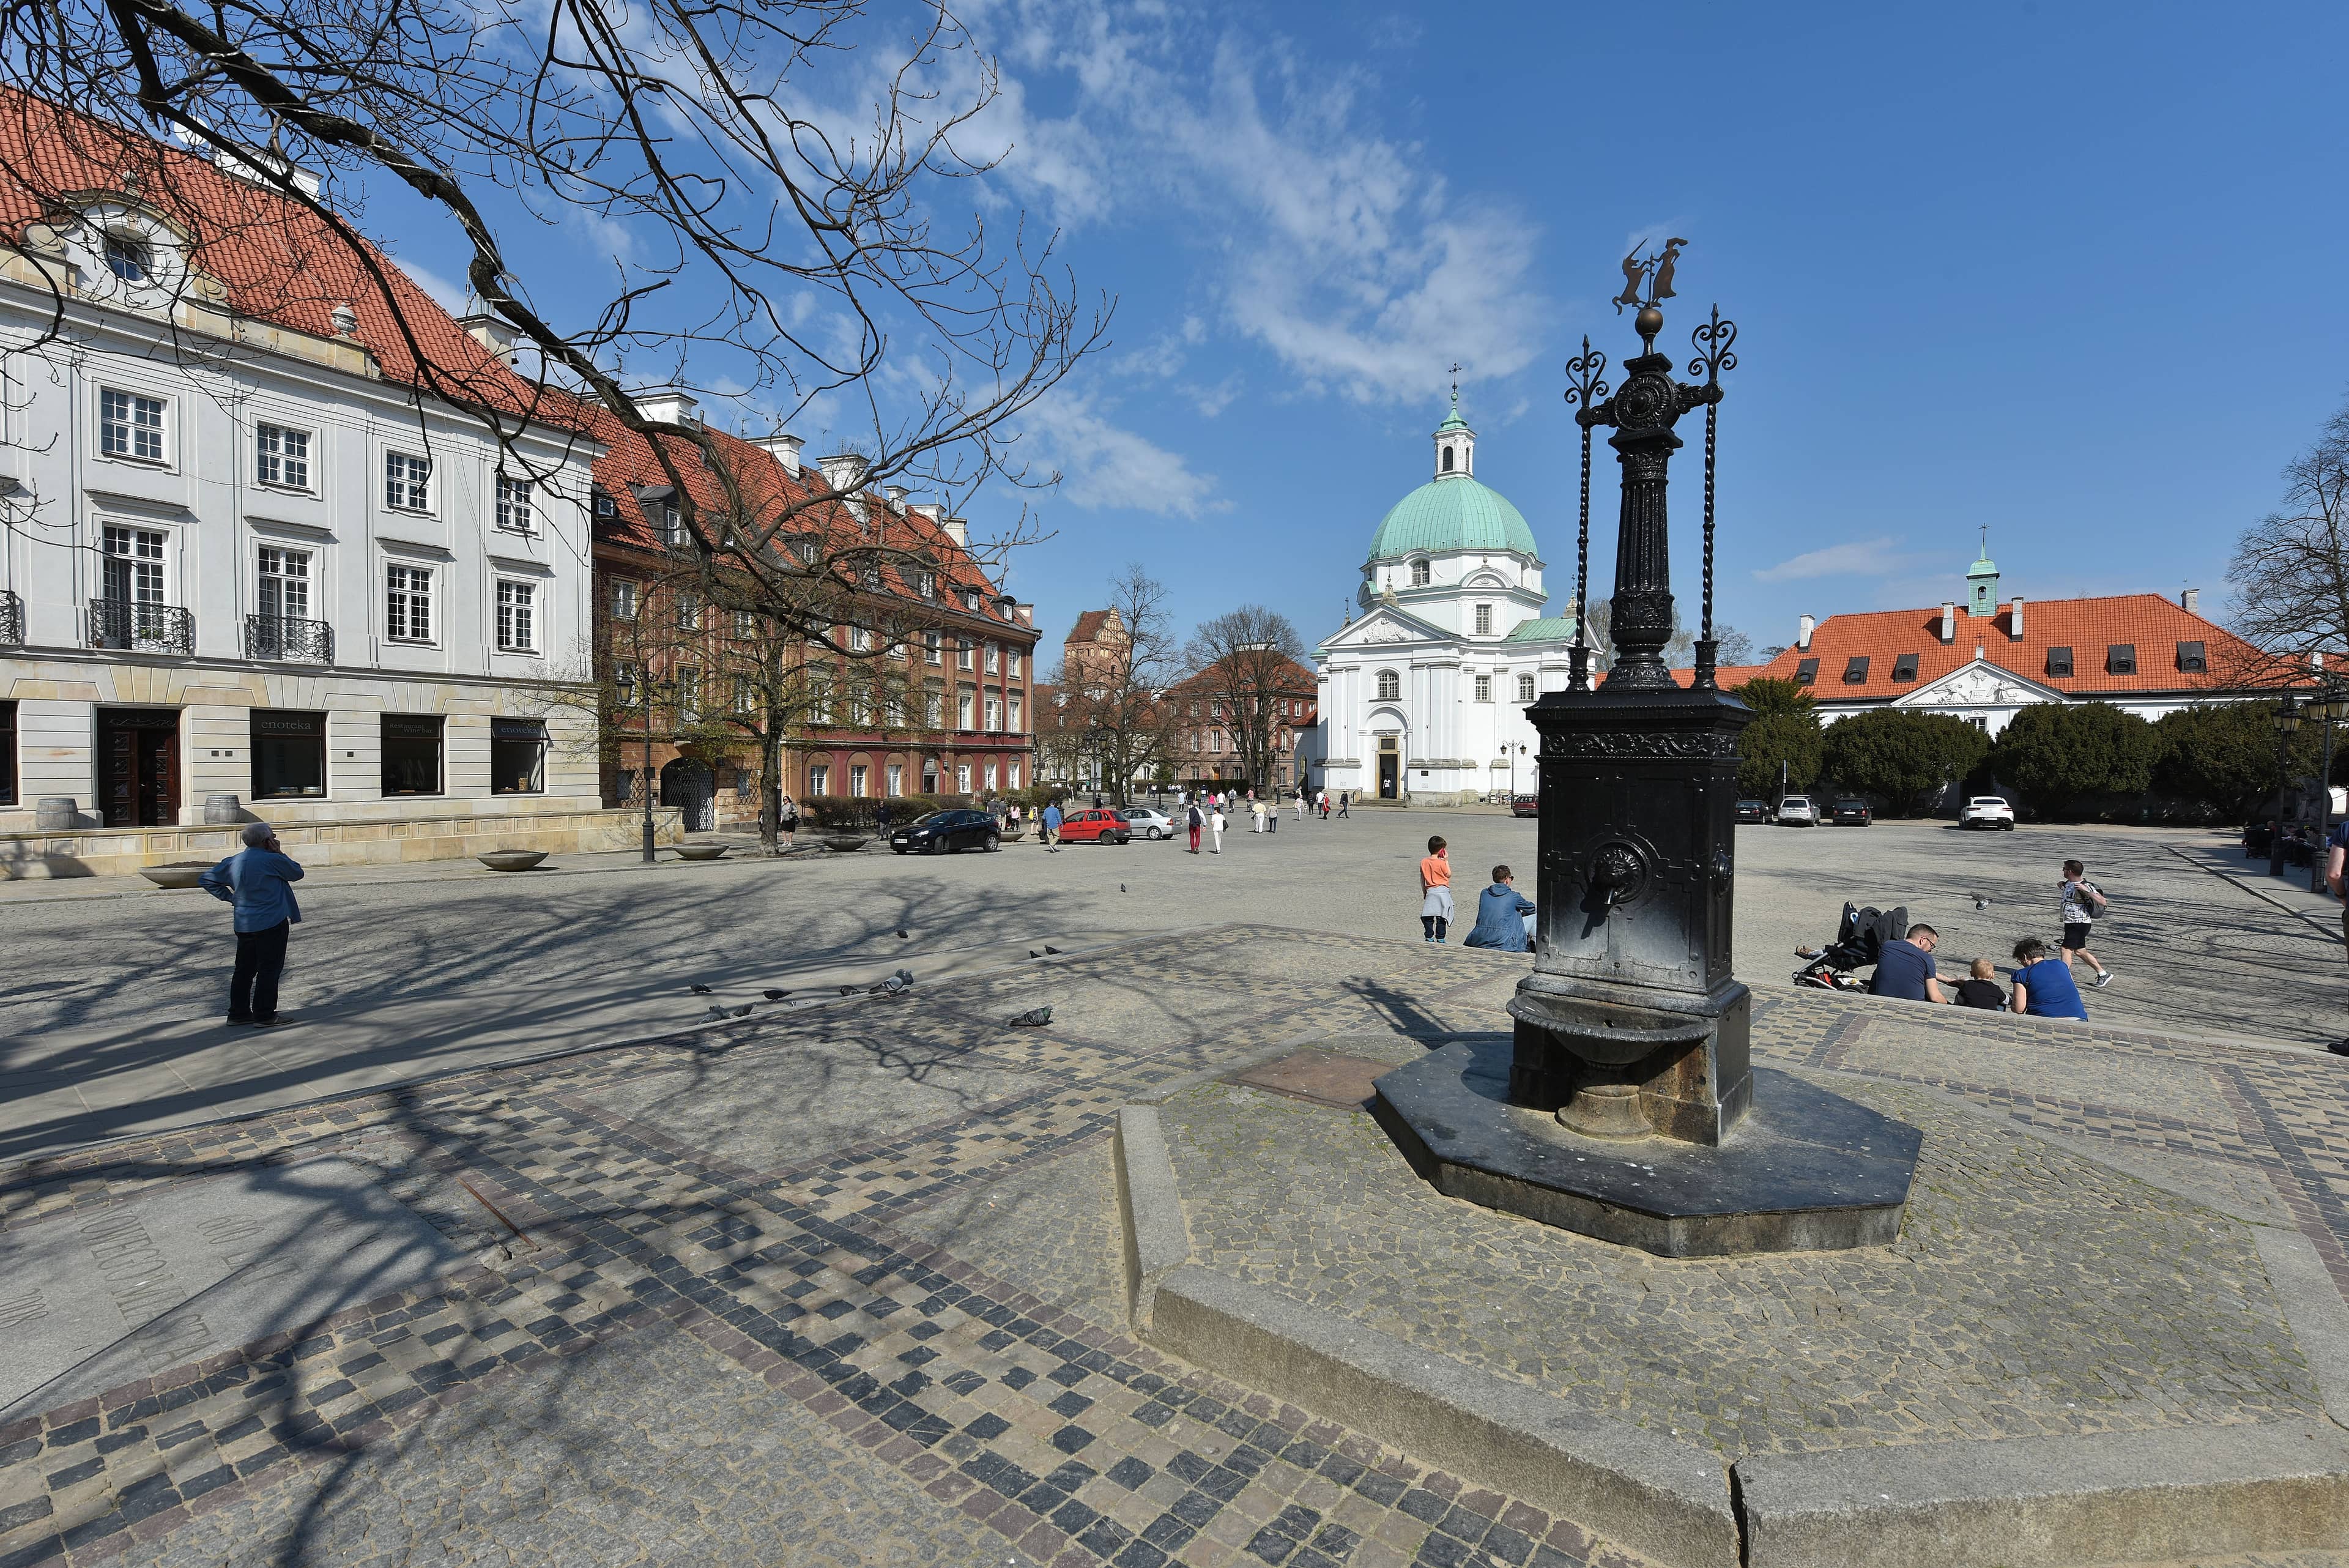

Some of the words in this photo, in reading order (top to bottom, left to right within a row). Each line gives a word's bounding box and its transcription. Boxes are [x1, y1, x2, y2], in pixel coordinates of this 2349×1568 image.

[261, 719, 311, 729] enoteka
[74, 1203, 167, 1282] NOWEGO
[196, 1214, 265, 1244] 600
[220, 1239, 305, 1288] LAT
[0, 1287, 49, 1330] 2008
[110, 1273, 220, 1372] MIASTA
